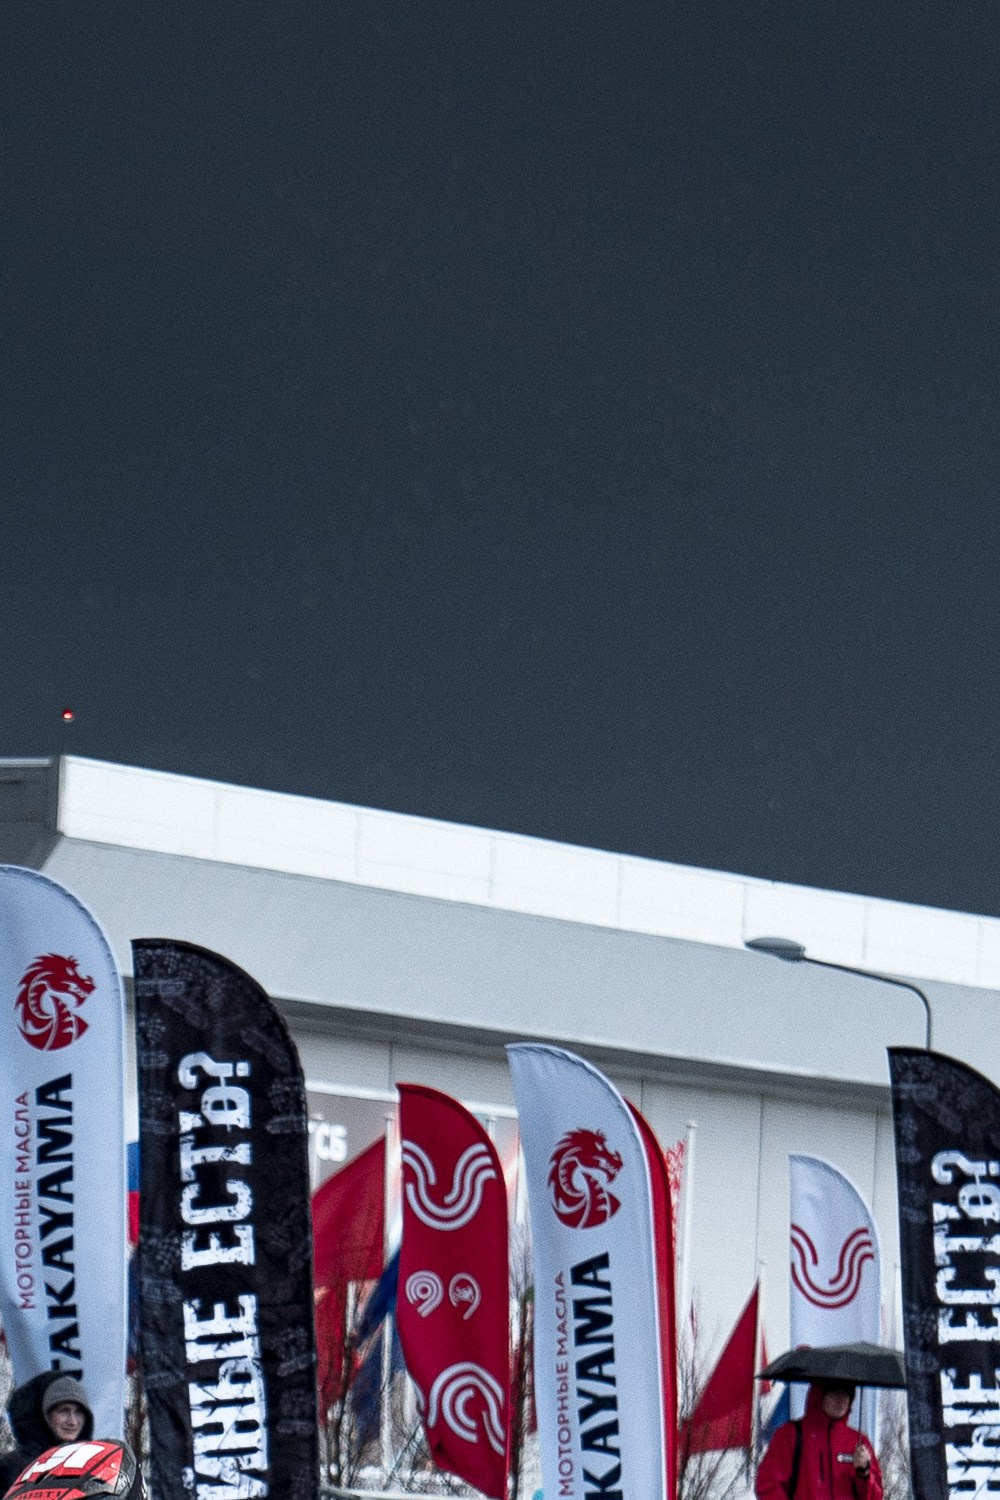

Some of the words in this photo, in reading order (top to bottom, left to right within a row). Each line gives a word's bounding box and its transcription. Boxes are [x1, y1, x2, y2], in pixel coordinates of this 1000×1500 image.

[14, 1090, 30, 1173] МАСЛА
[178, 1052, 256, 1271] ЕСТЬ?
[14, 1180, 35, 1310] МОТОРНЫЕ
[555, 1270, 569, 1357] МАСЛА
[556, 1362, 574, 1497] МОТОРНЫЕ
